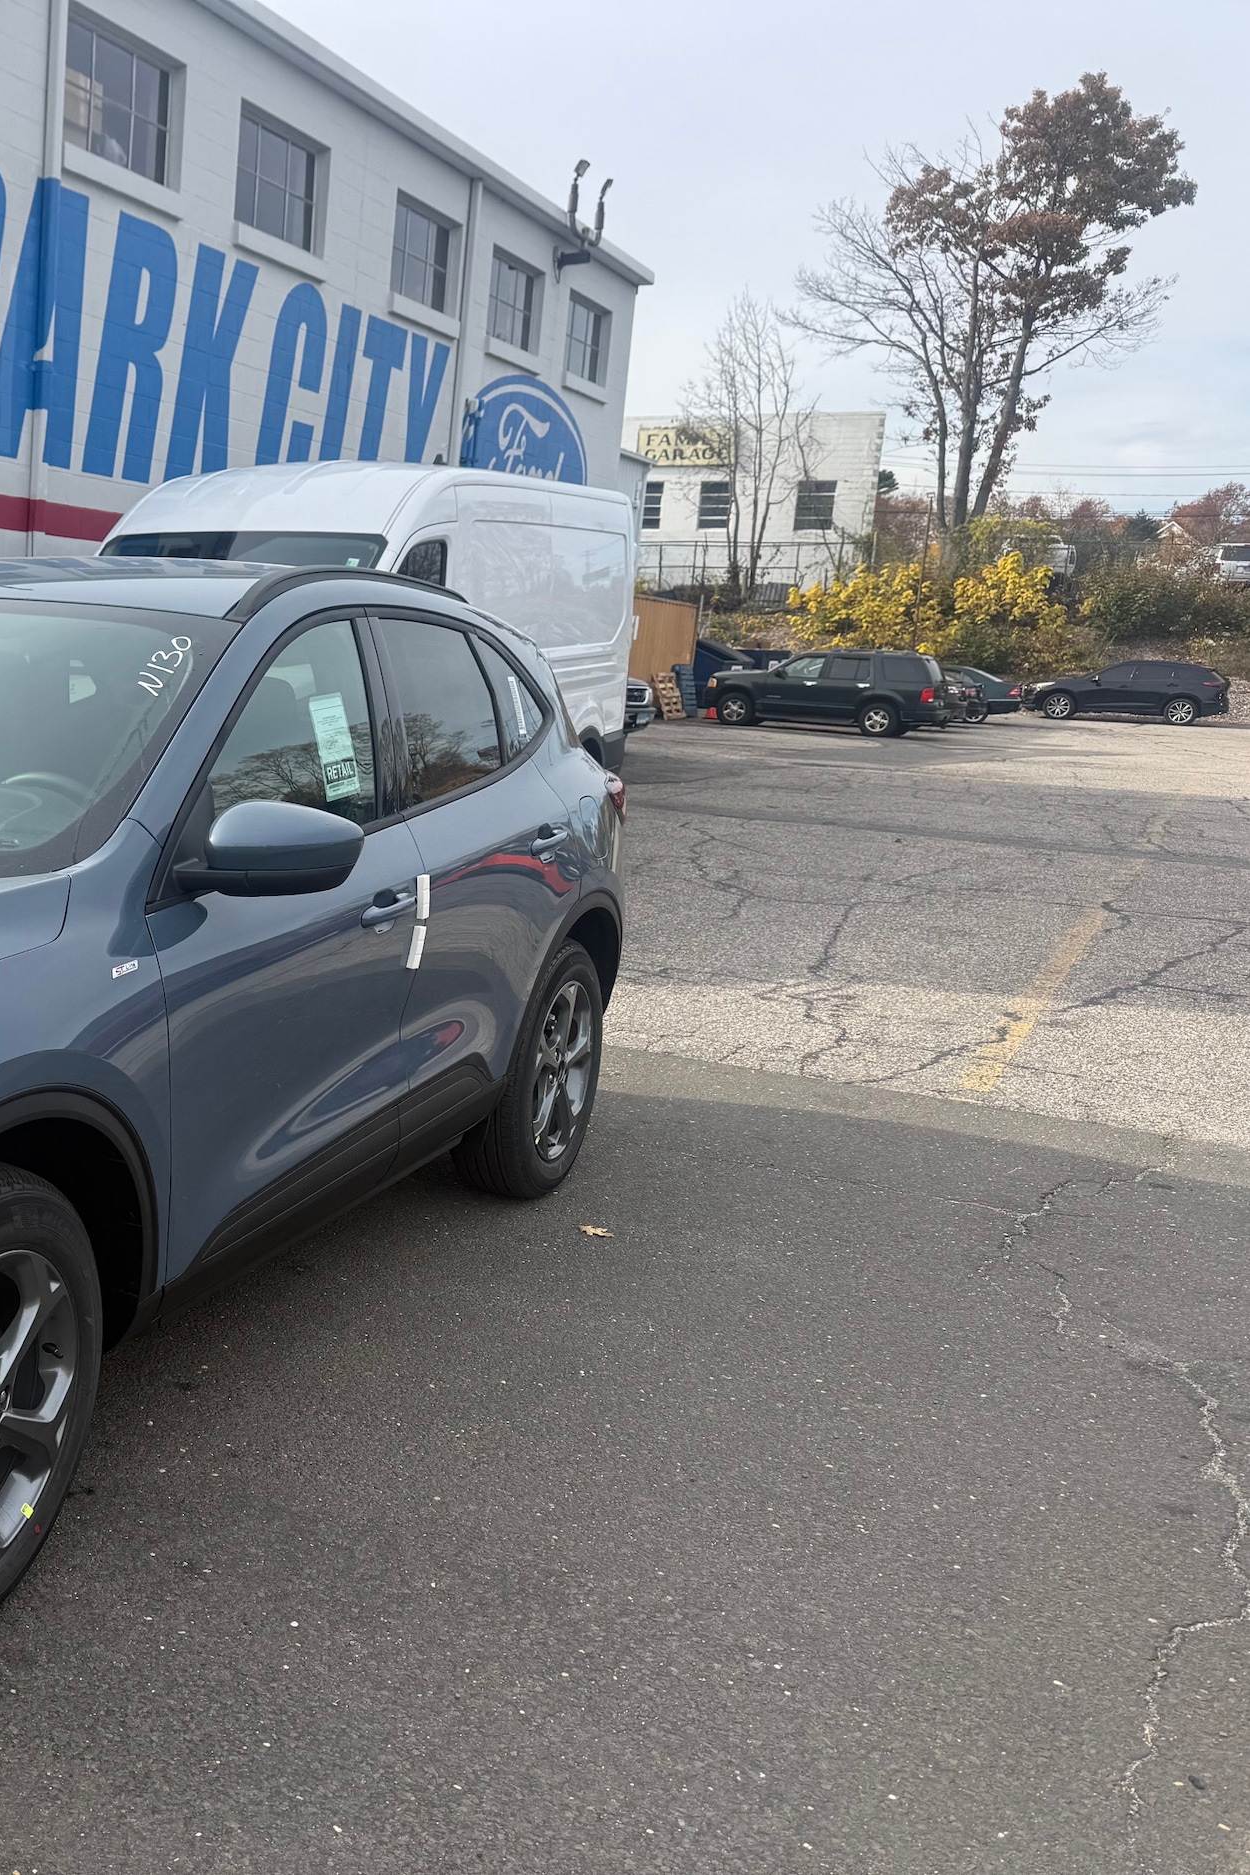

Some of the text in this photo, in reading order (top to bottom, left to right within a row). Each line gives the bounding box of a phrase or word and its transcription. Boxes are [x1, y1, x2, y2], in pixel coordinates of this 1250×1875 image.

[254, 282, 450, 466] CITY
[137, 635, 192, 697] N130
[326, 761, 354, 781] RETAIL
